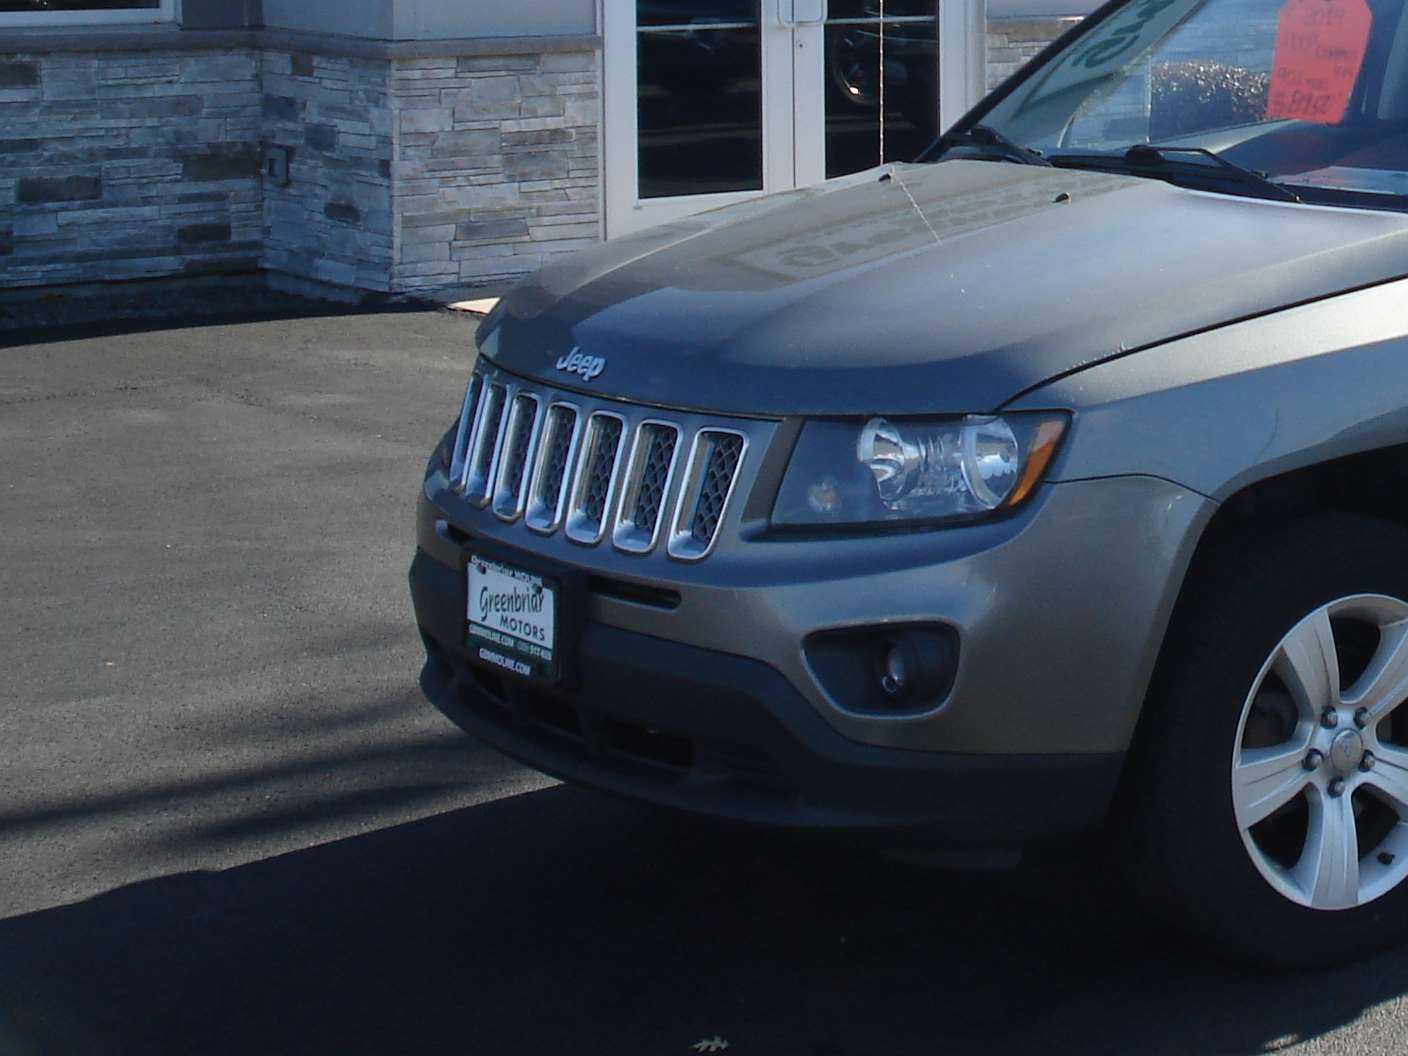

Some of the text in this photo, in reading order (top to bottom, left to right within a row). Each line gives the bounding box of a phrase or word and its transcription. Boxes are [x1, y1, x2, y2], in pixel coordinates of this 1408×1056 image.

[556, 346, 606, 381] Jeep
[479, 585, 544, 622] Greenbriar
[500, 615, 545, 642] MOTORS
